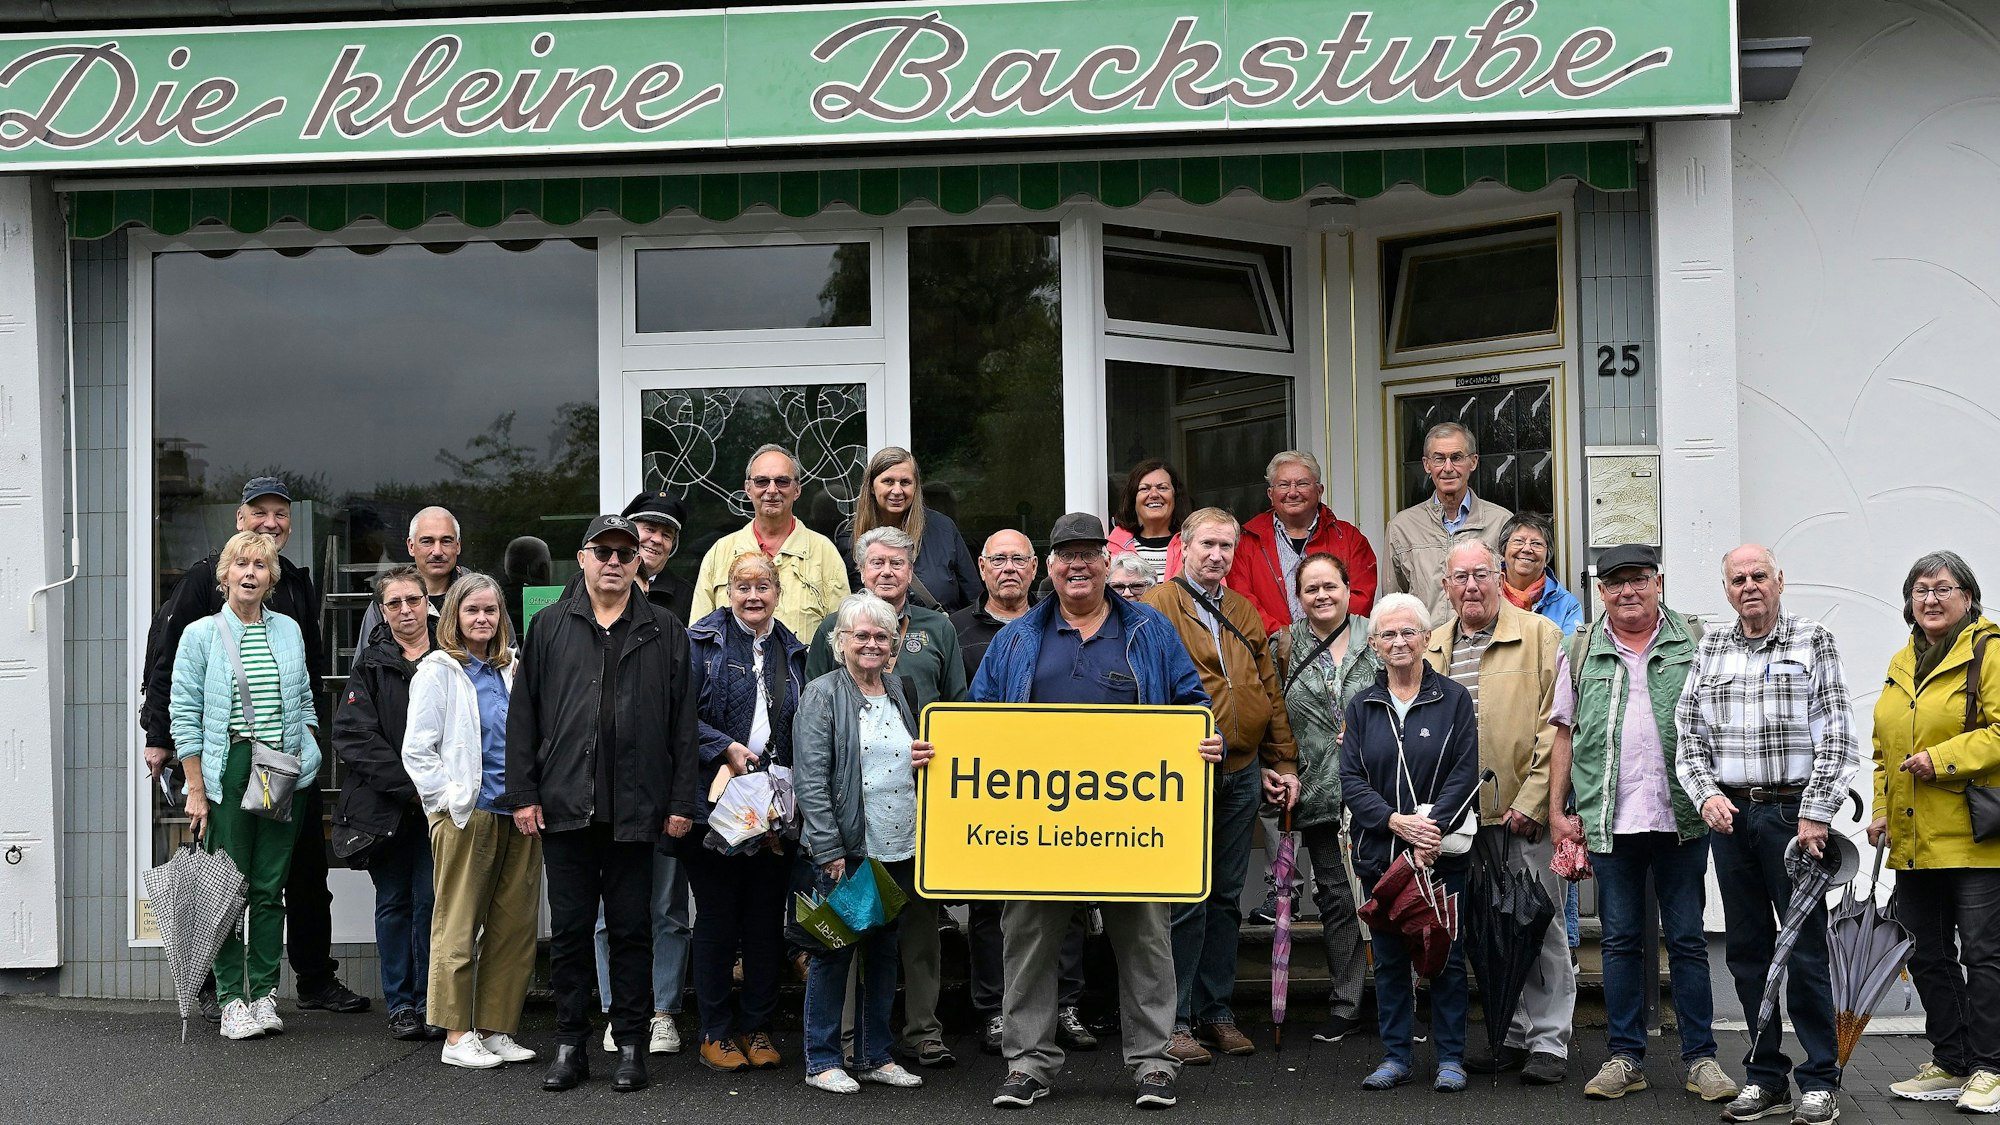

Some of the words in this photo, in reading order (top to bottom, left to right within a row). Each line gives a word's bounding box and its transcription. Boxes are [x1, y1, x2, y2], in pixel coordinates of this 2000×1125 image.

[0, 41, 286, 151] Die
[299, 31, 725, 141] kleine
[810, 0, 1673, 124] Backstube
[1597, 344, 1640, 377] 25
[950, 757, 1185, 812] Hengasch
[967, 823, 1029, 846] Kreis
[1038, 824, 1164, 848] Liebernich
[814, 920, 846, 949] SPRIT
